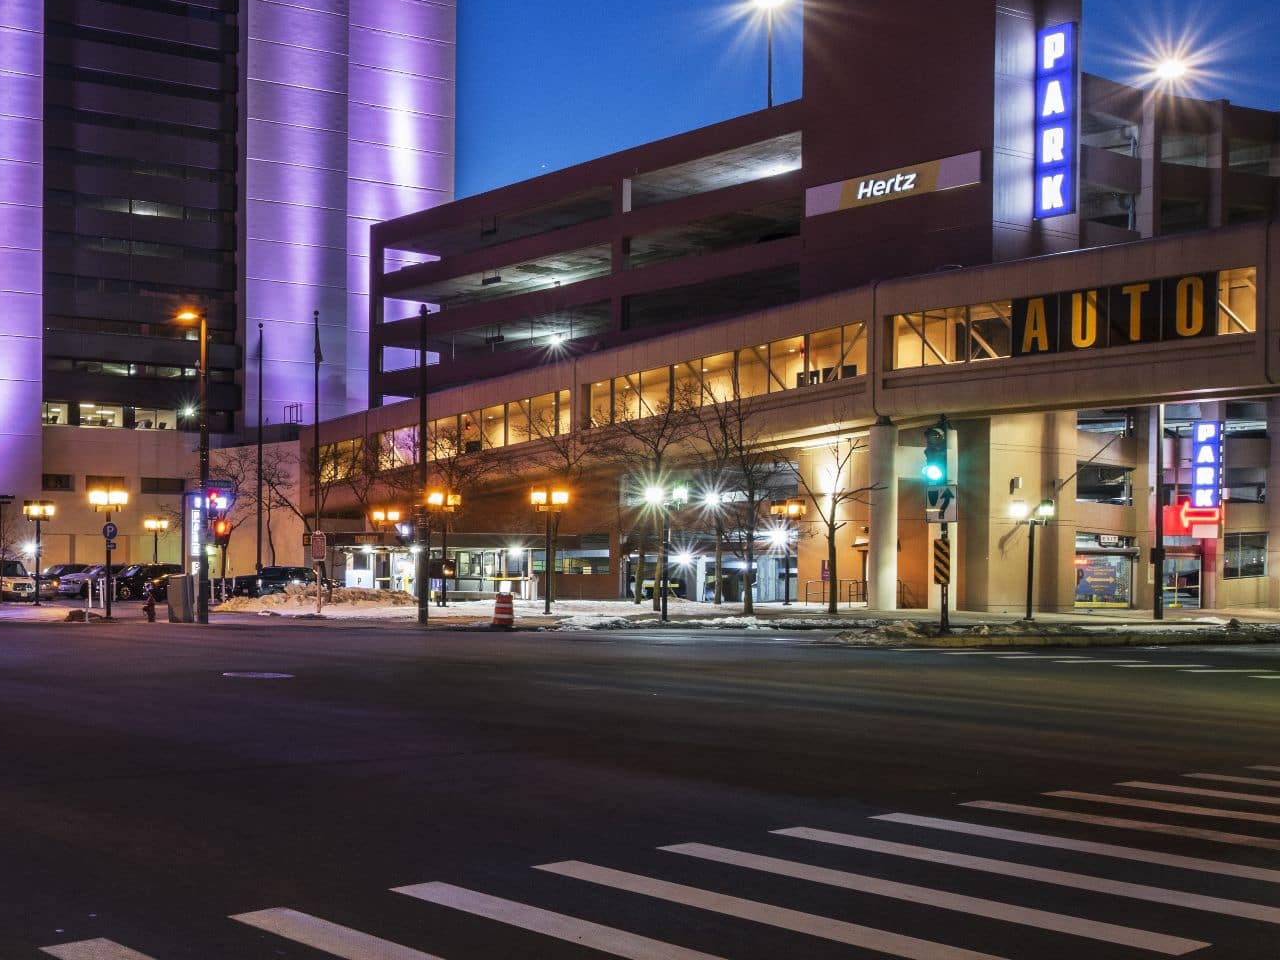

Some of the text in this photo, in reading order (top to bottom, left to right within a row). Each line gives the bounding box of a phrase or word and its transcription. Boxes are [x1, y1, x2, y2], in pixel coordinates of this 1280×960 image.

[1042, 32, 1065, 211] PARK
[857, 173, 917, 200] Hertz
[1022, 276, 1204, 353] AUTO
[1195, 424, 1216, 507] PARK
